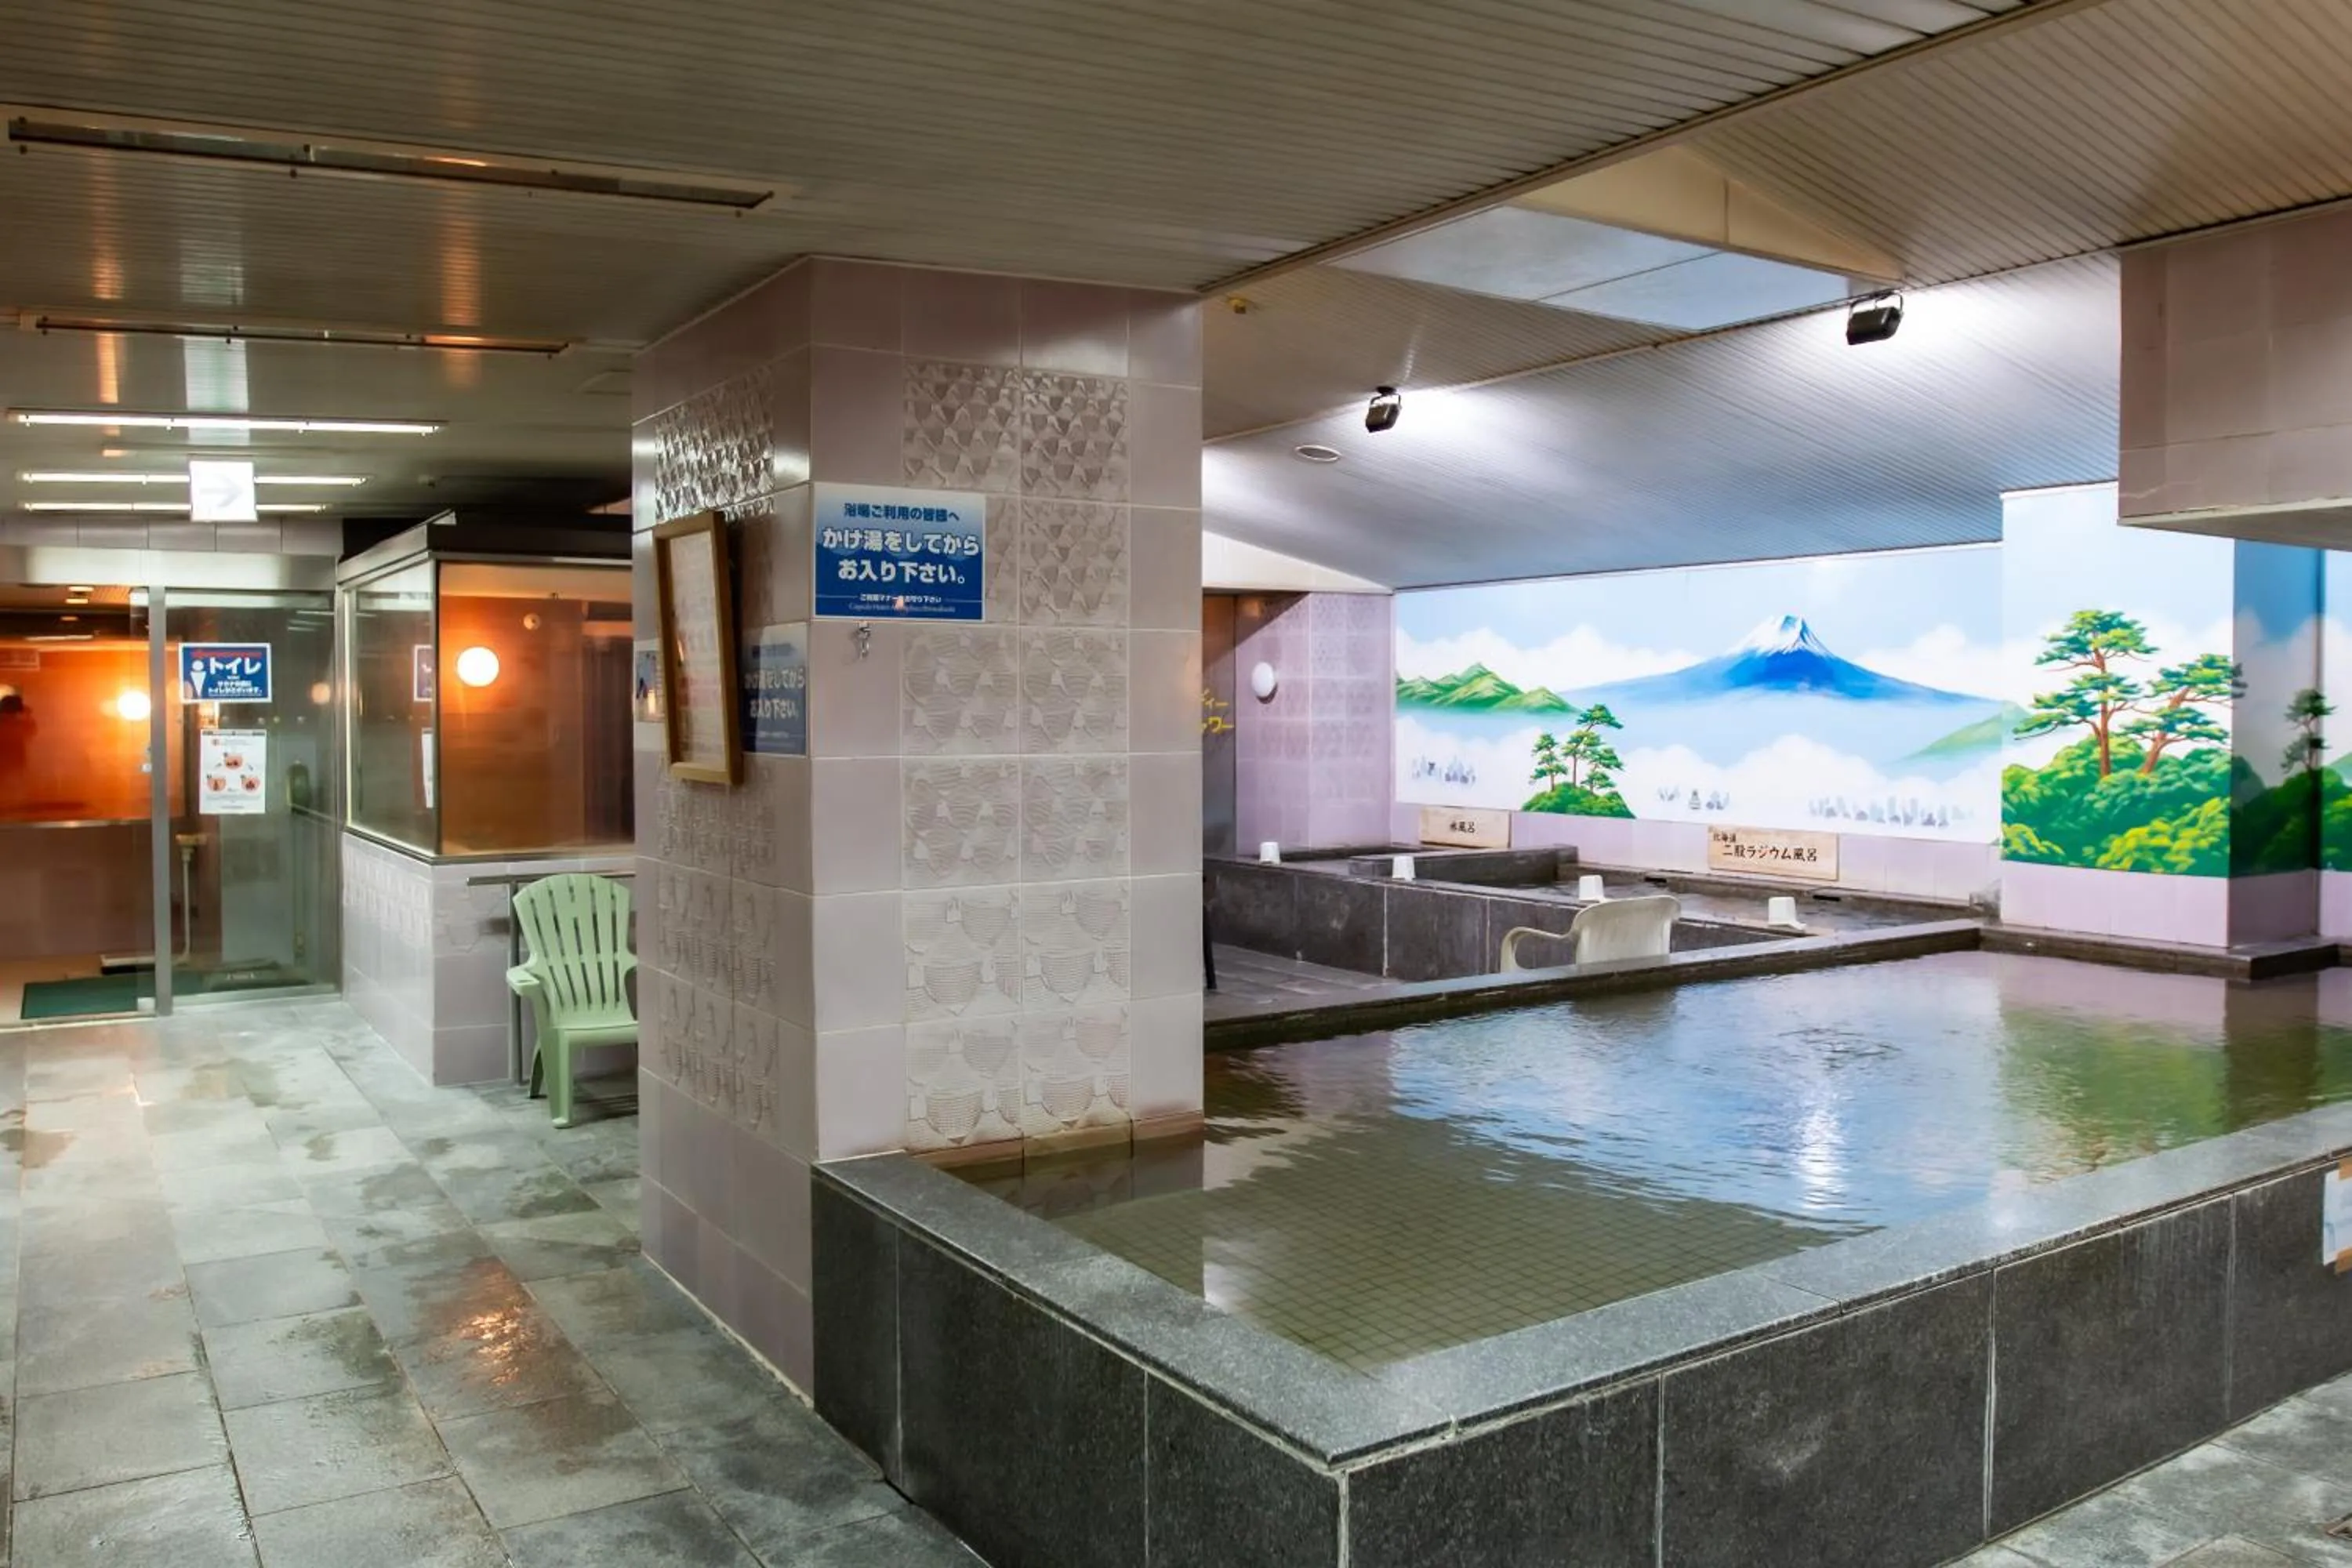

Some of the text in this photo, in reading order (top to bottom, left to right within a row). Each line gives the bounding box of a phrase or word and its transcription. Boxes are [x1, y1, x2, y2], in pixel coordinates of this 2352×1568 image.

[822, 526, 980, 556] かけ湯をしてから
[838, 559, 965, 584] お入り下さい。
[209, 657, 262, 675] トイレ
[1722, 844, 1818, 862] 二股ラジウム風呂
